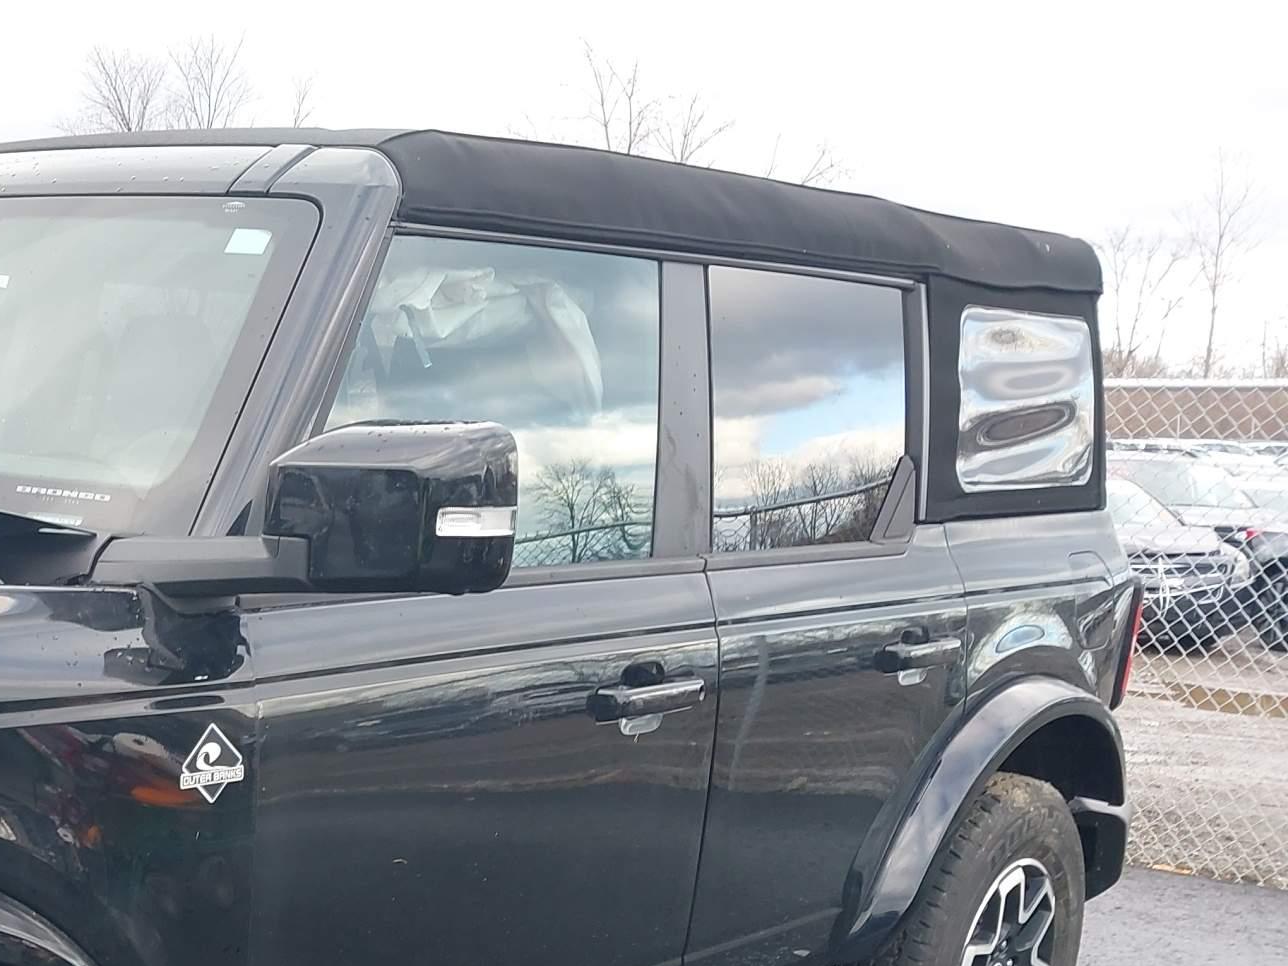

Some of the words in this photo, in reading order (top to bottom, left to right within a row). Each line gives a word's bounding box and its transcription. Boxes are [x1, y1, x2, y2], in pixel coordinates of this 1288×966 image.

[16, 485, 111, 501] BRONCO
[183, 773, 212, 786] OUTER
[213, 768, 242, 781] BANKS
